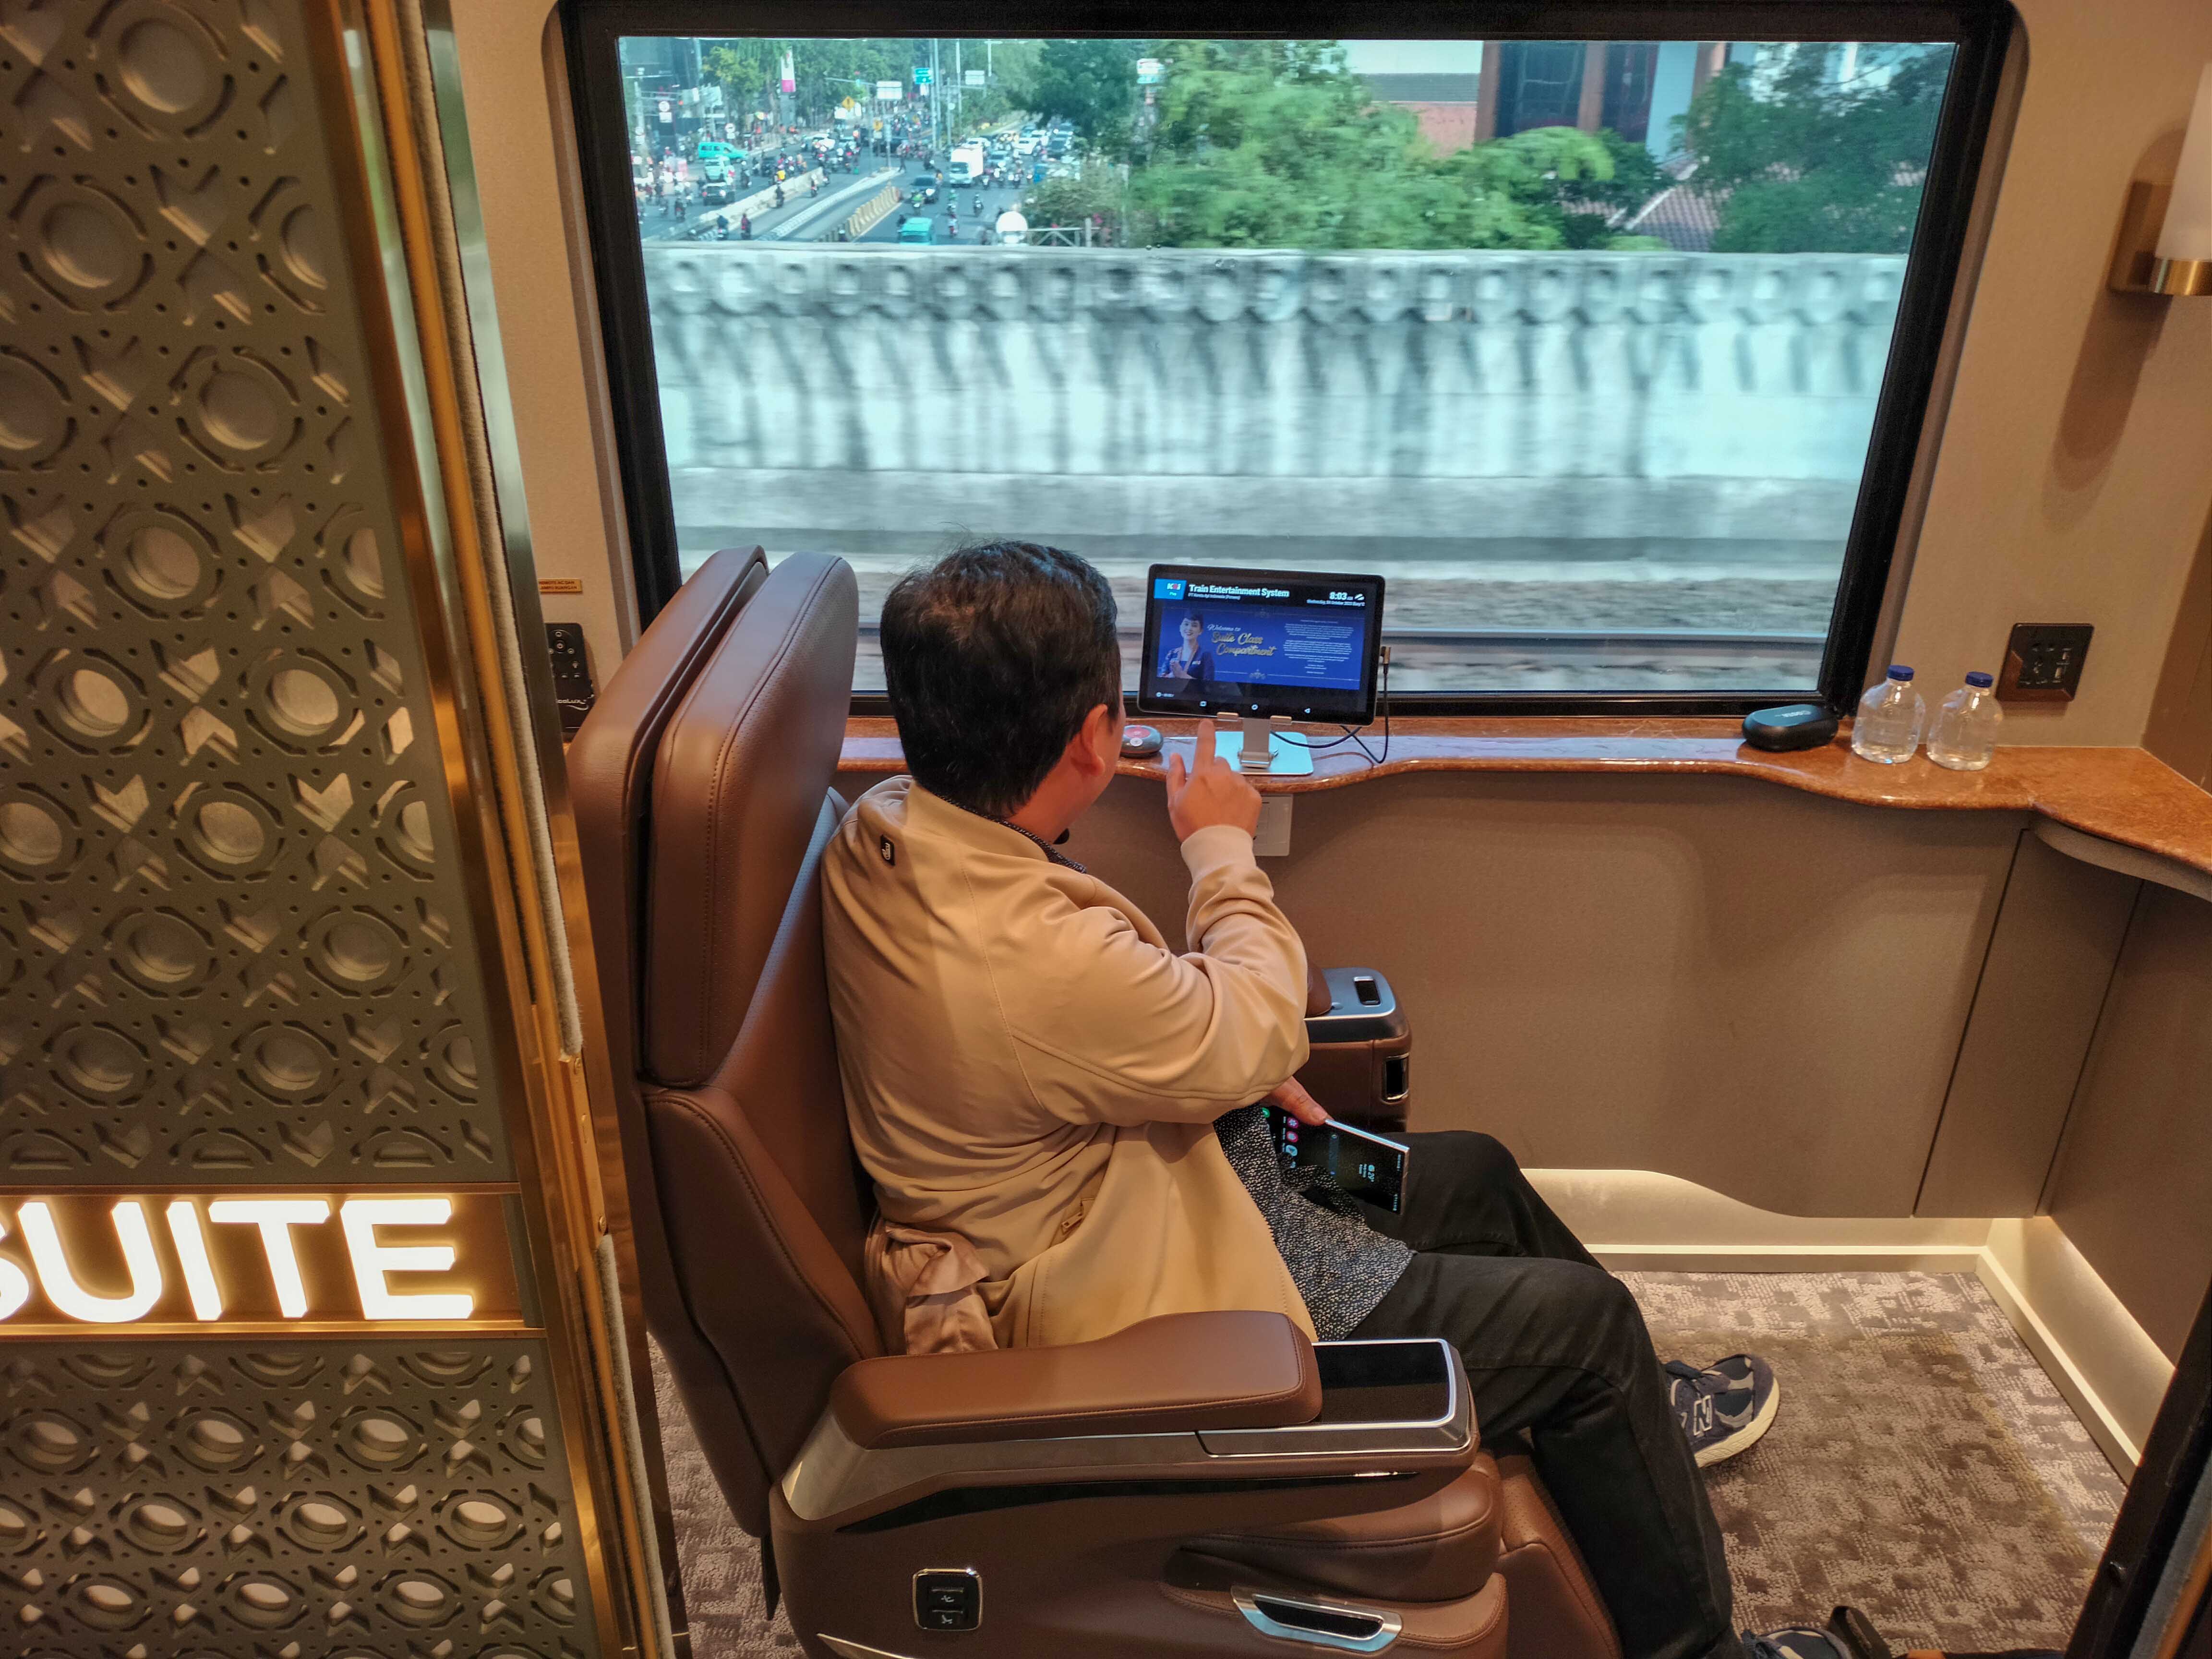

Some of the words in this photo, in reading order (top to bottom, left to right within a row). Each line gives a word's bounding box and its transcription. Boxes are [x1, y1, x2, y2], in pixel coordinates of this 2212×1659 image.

[1189, 584, 1208, 593] Train
[1209, 585, 1261, 596] Entertainment
[1262, 588, 1290, 599] System
[1329, 591, 1347, 600] 8:03
[1212, 631, 1236, 643] Suite
[1238, 632, 1263, 645] Class
[1217, 643, 1277, 657] Compartment
[0, 1199, 473, 1322] UITE
